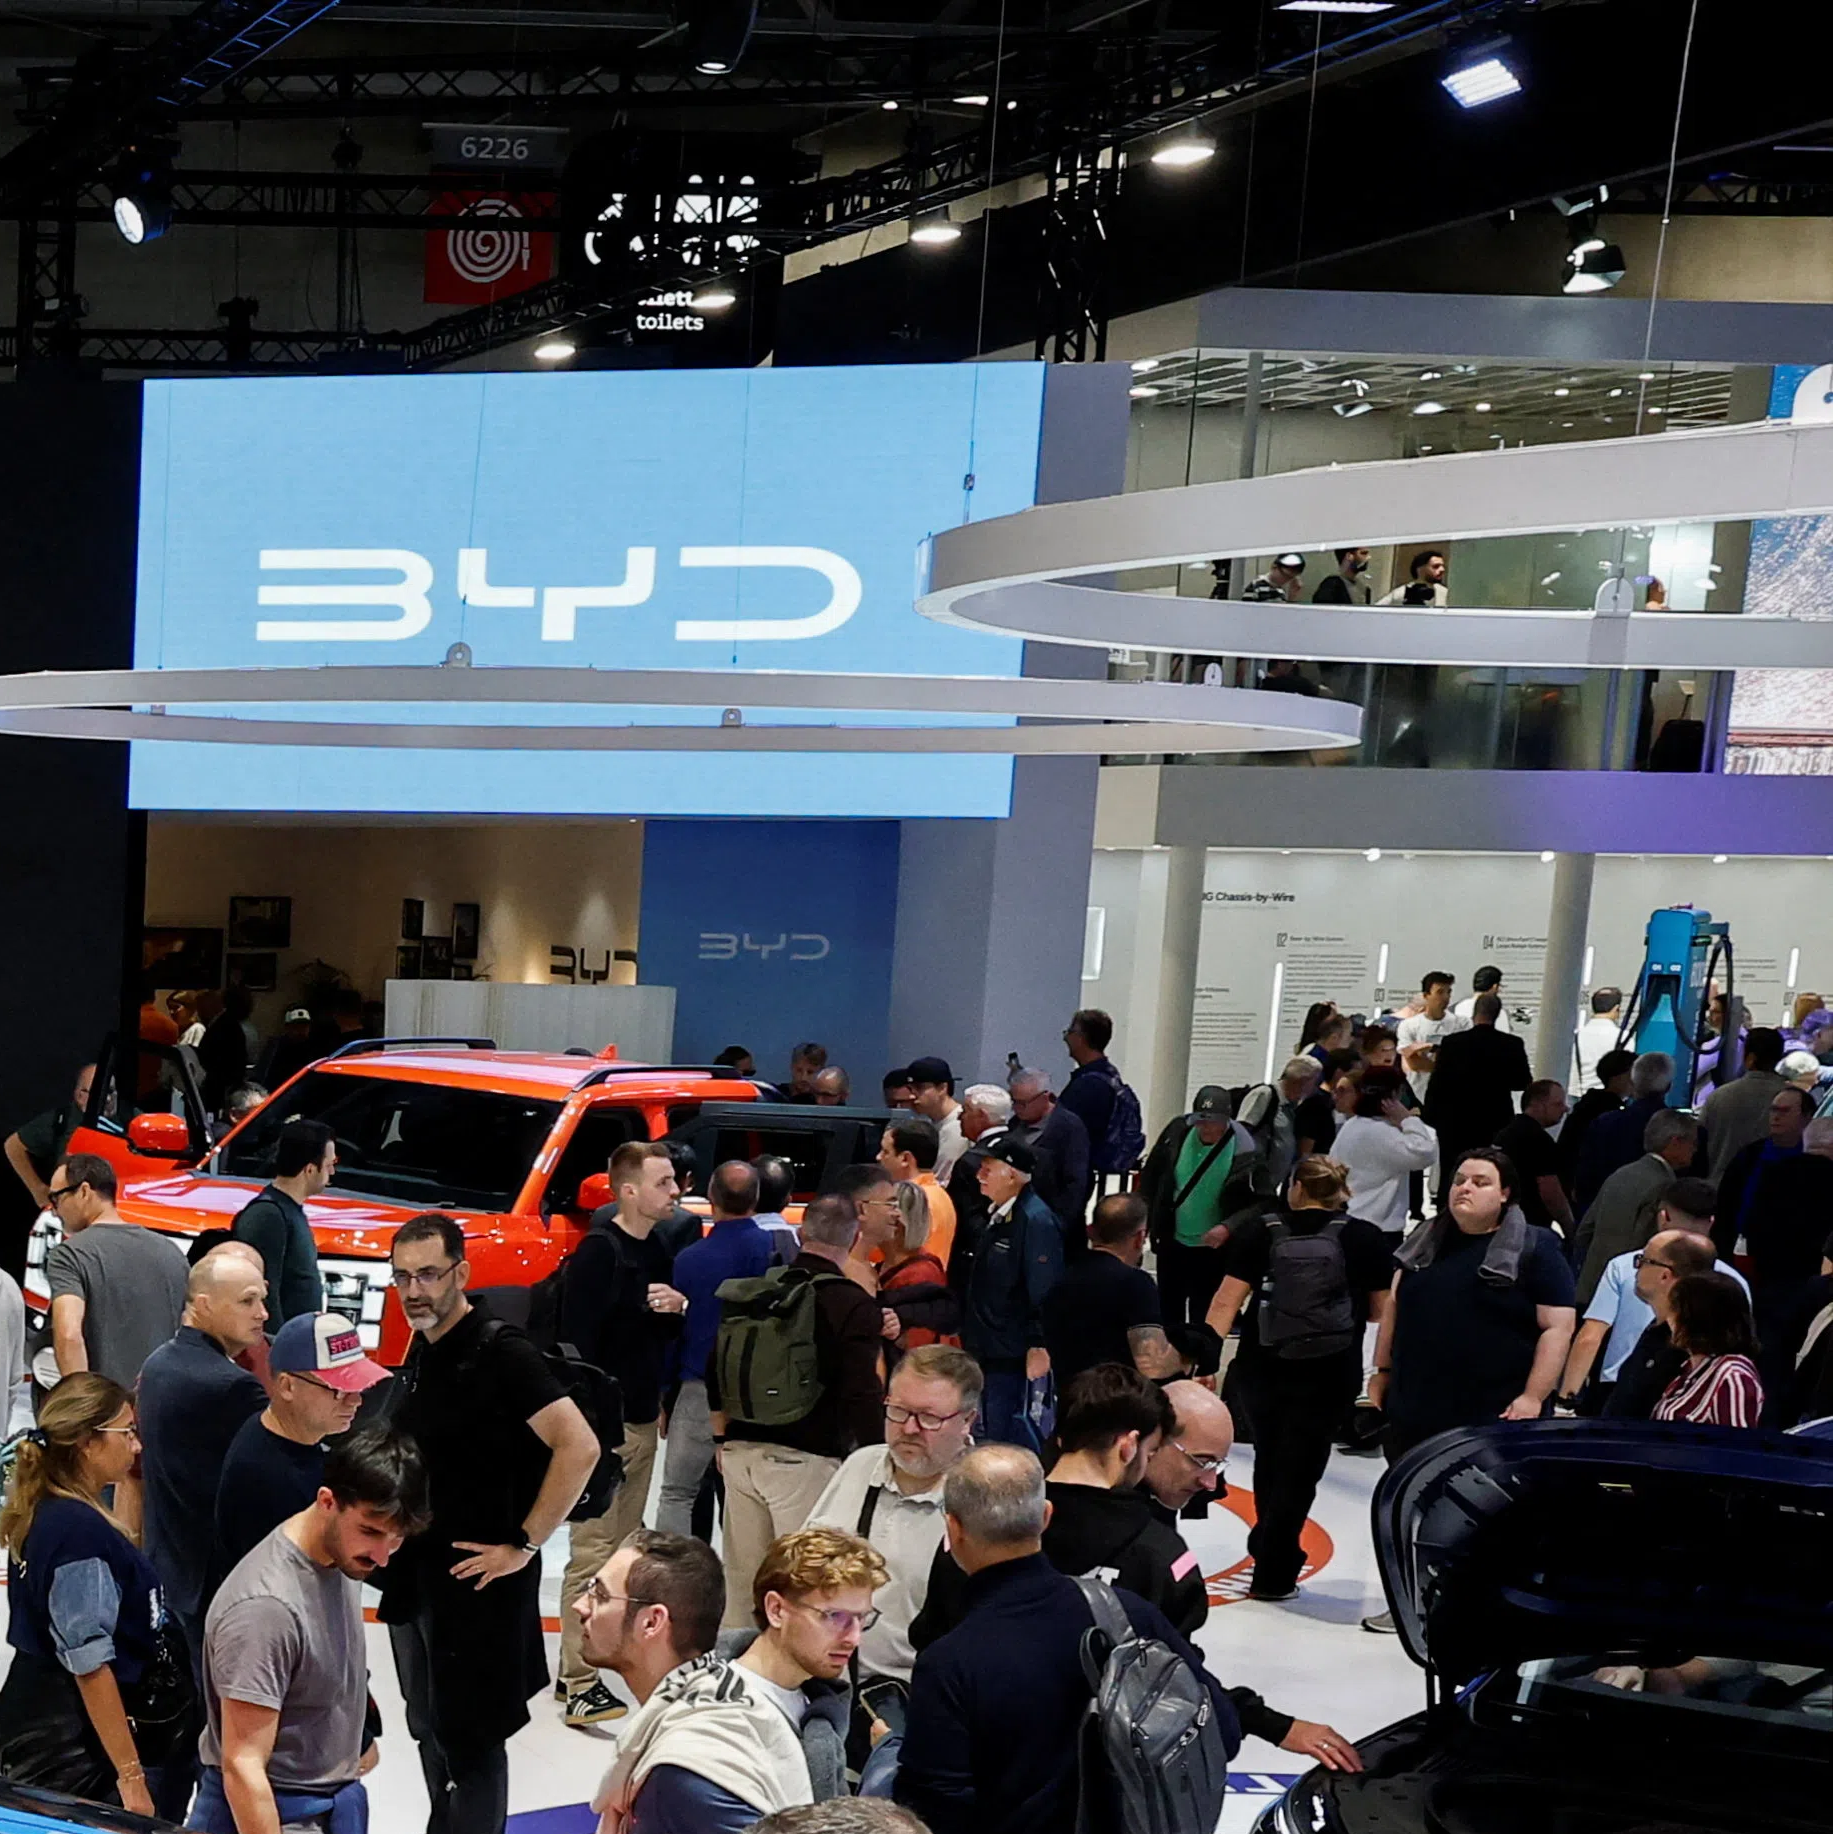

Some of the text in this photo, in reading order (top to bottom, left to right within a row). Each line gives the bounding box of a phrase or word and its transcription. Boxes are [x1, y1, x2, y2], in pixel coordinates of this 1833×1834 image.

[460, 136, 529, 160] 6226
[636, 312, 705, 331] toilets
[256, 546, 862, 641] BYD
[699, 931, 831, 962] BYD
